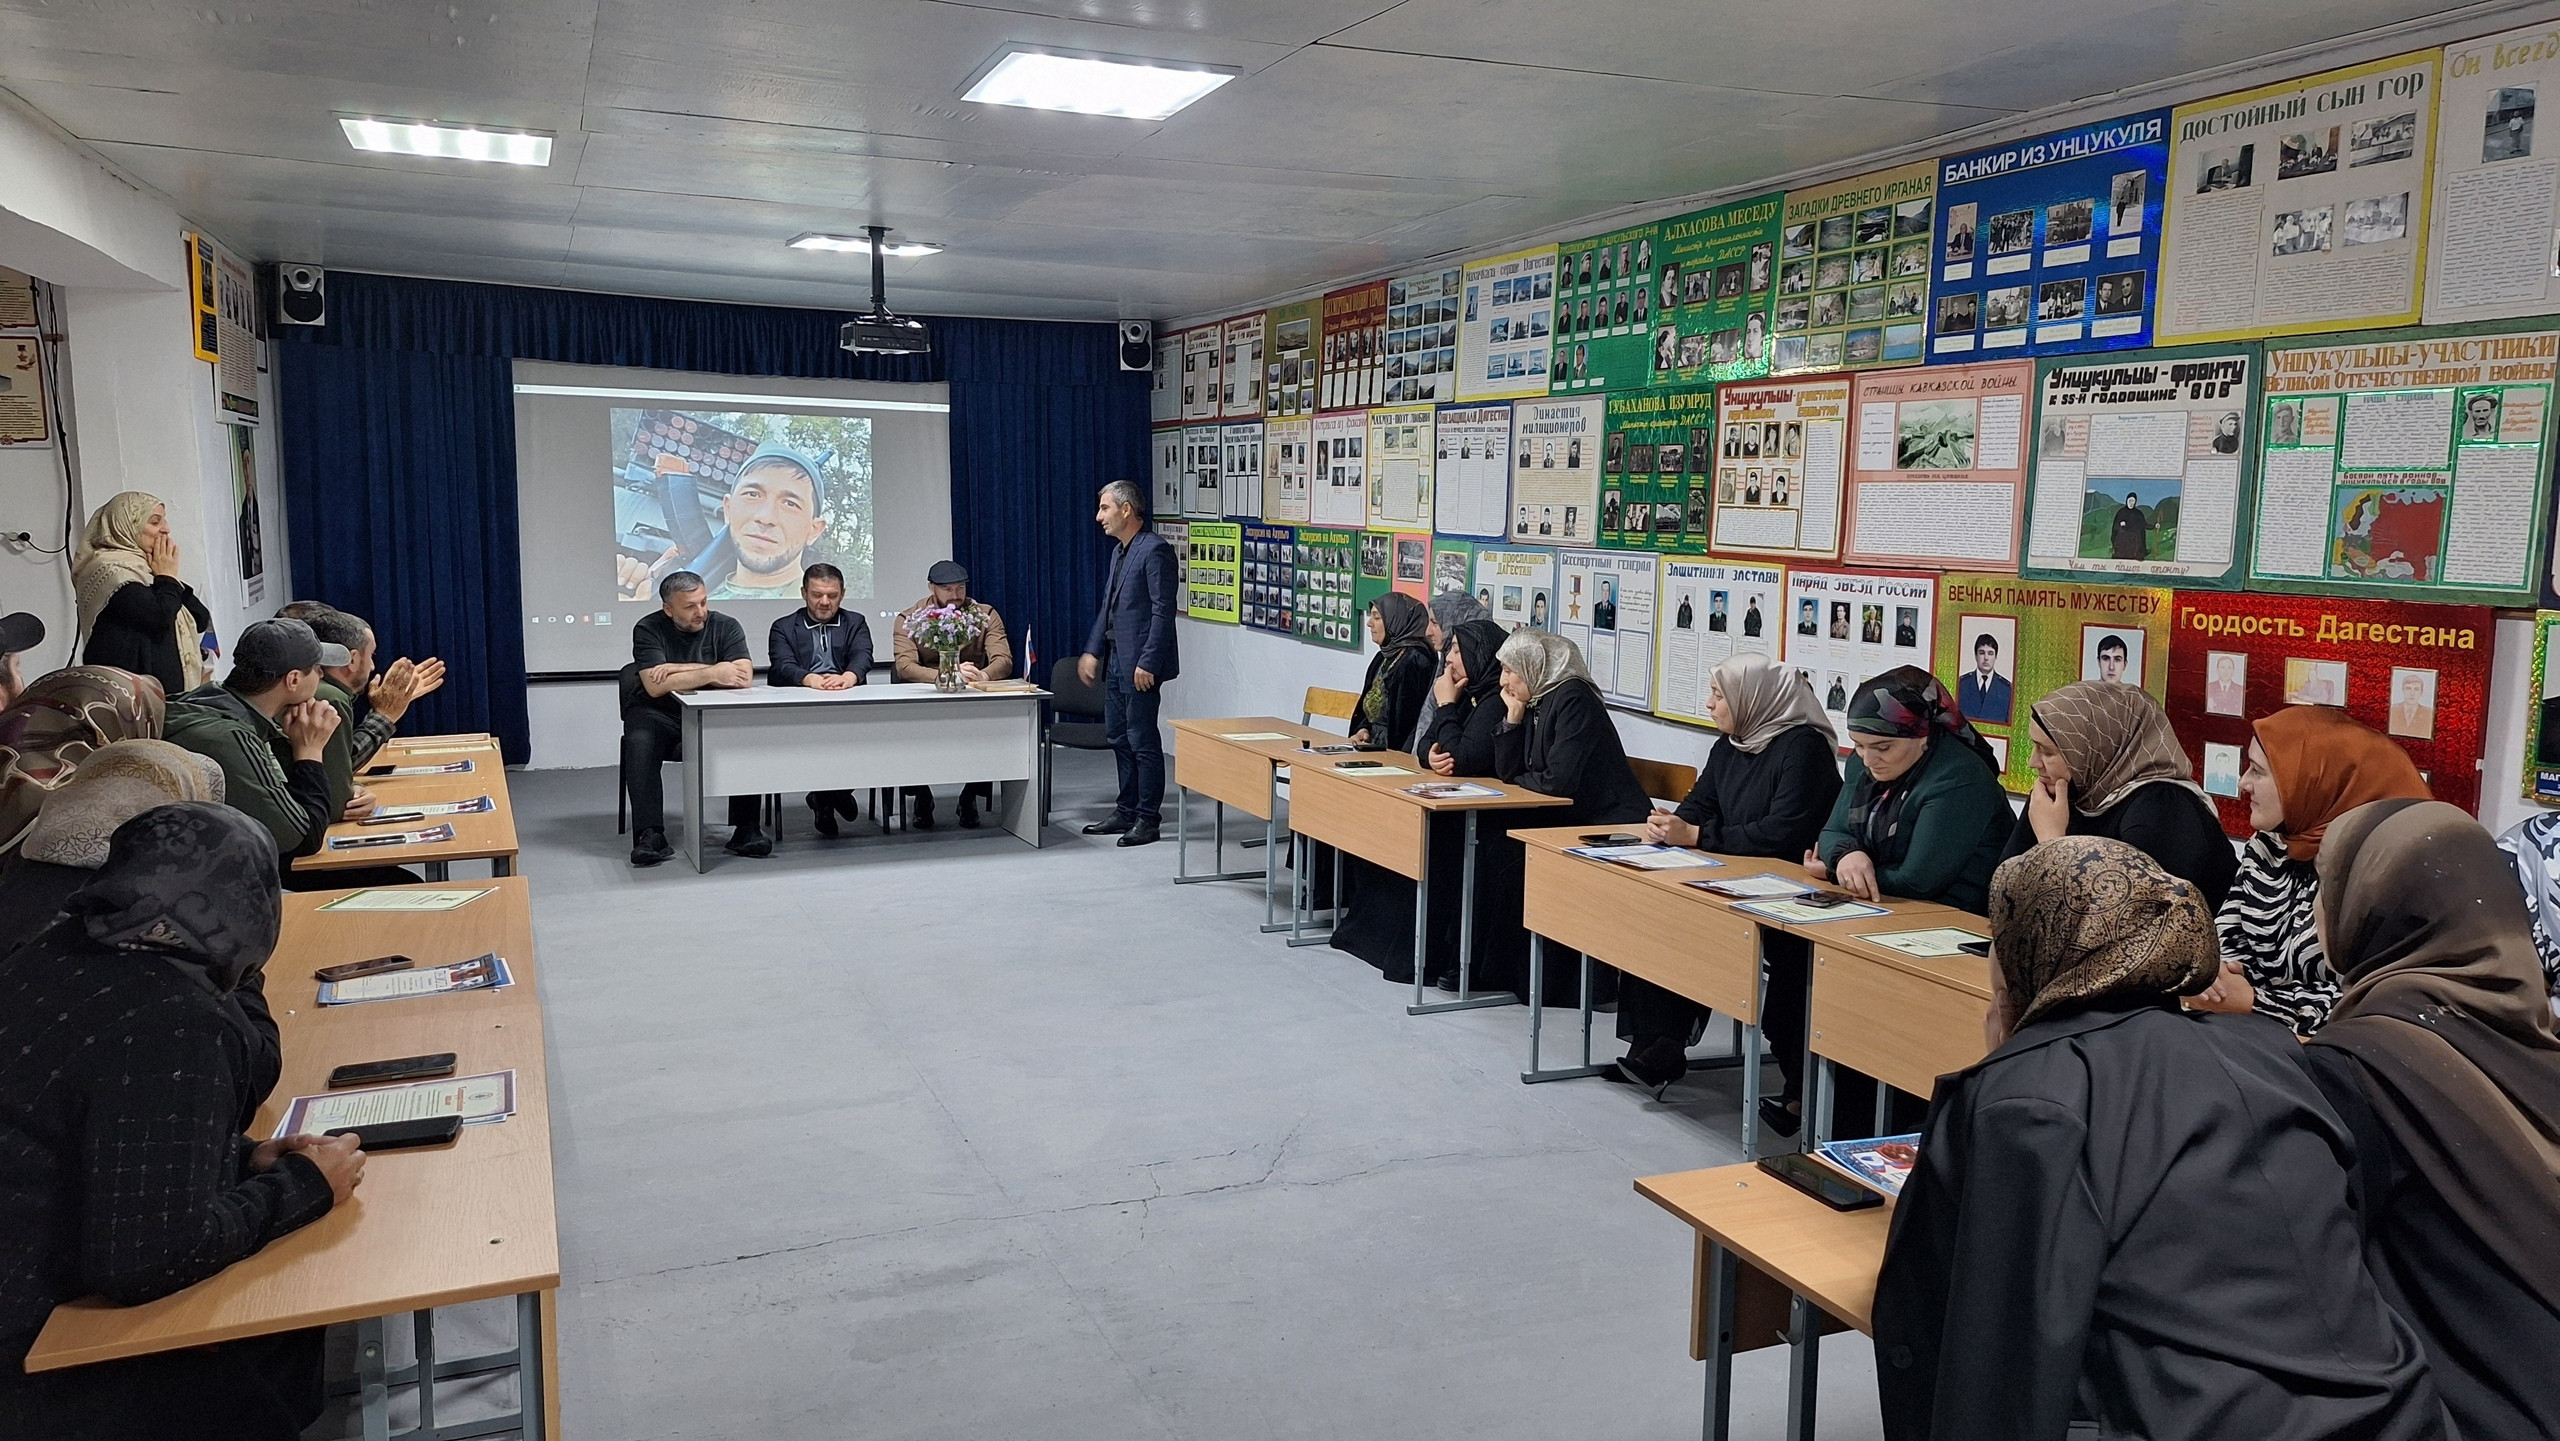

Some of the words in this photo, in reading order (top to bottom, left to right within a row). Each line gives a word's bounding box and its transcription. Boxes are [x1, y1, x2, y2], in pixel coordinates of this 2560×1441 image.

[2450, 51, 2480, 78] Он
[2180, 95, 2306, 144] ДОСТОЙНЫЙ
[2316, 85, 2365, 113] СЫН
[2377, 72, 2424, 100] ГОР
[1944, 151, 2017, 183] БАНКИР
[2020, 145, 2045, 166] ИЗ
[2049, 118, 2162, 161] УНЦУКУЛЯ
[1788, 198, 1829, 220] ЗАГАДКИ
[1831, 187, 1881, 214] ДРЕВНЕГО
[1884, 175, 1931, 201] ИРГАНАЯ
[1663, 213, 1726, 241] АЛХАСОВА
[1727, 201, 1778, 228] МЕСЕДУ
[1863, 384, 1904, 397] СТРАНИЦЫ
[1909, 375, 1975, 393] КАВКАЗСКОЙ
[1980, 373, 2017, 390] ВОЙНЫ
[2265, 372, 2330, 392] ВЕЛИКОЙ
[2334, 363, 2481, 388] ОТЕЧЕСТВЕННОЙ
[2488, 360, 2557, 382] ВОЙНЫ
[1533, 406, 1581, 420] Династия
[1608, 396, 1666, 414] ГУБАХАНОВА
[1669, 393, 1712, 411] ИЗУМРУД
[1522, 417, 1587, 437] милиционеров
[2068, 559, 2086, 570] Чем
[2092, 562, 2107, 571] ты
[2114, 562, 2141, 572] помог
[1949, 584, 2002, 603] ВЕЧНАЯ
[2006, 588, 2066, 609] ПАМЯТЬ
[2070, 592, 2161, 615] МУЖЕСТВУ
[2181, 606, 2305, 637] Гордость
[2316, 614, 2476, 649] Дагестана
